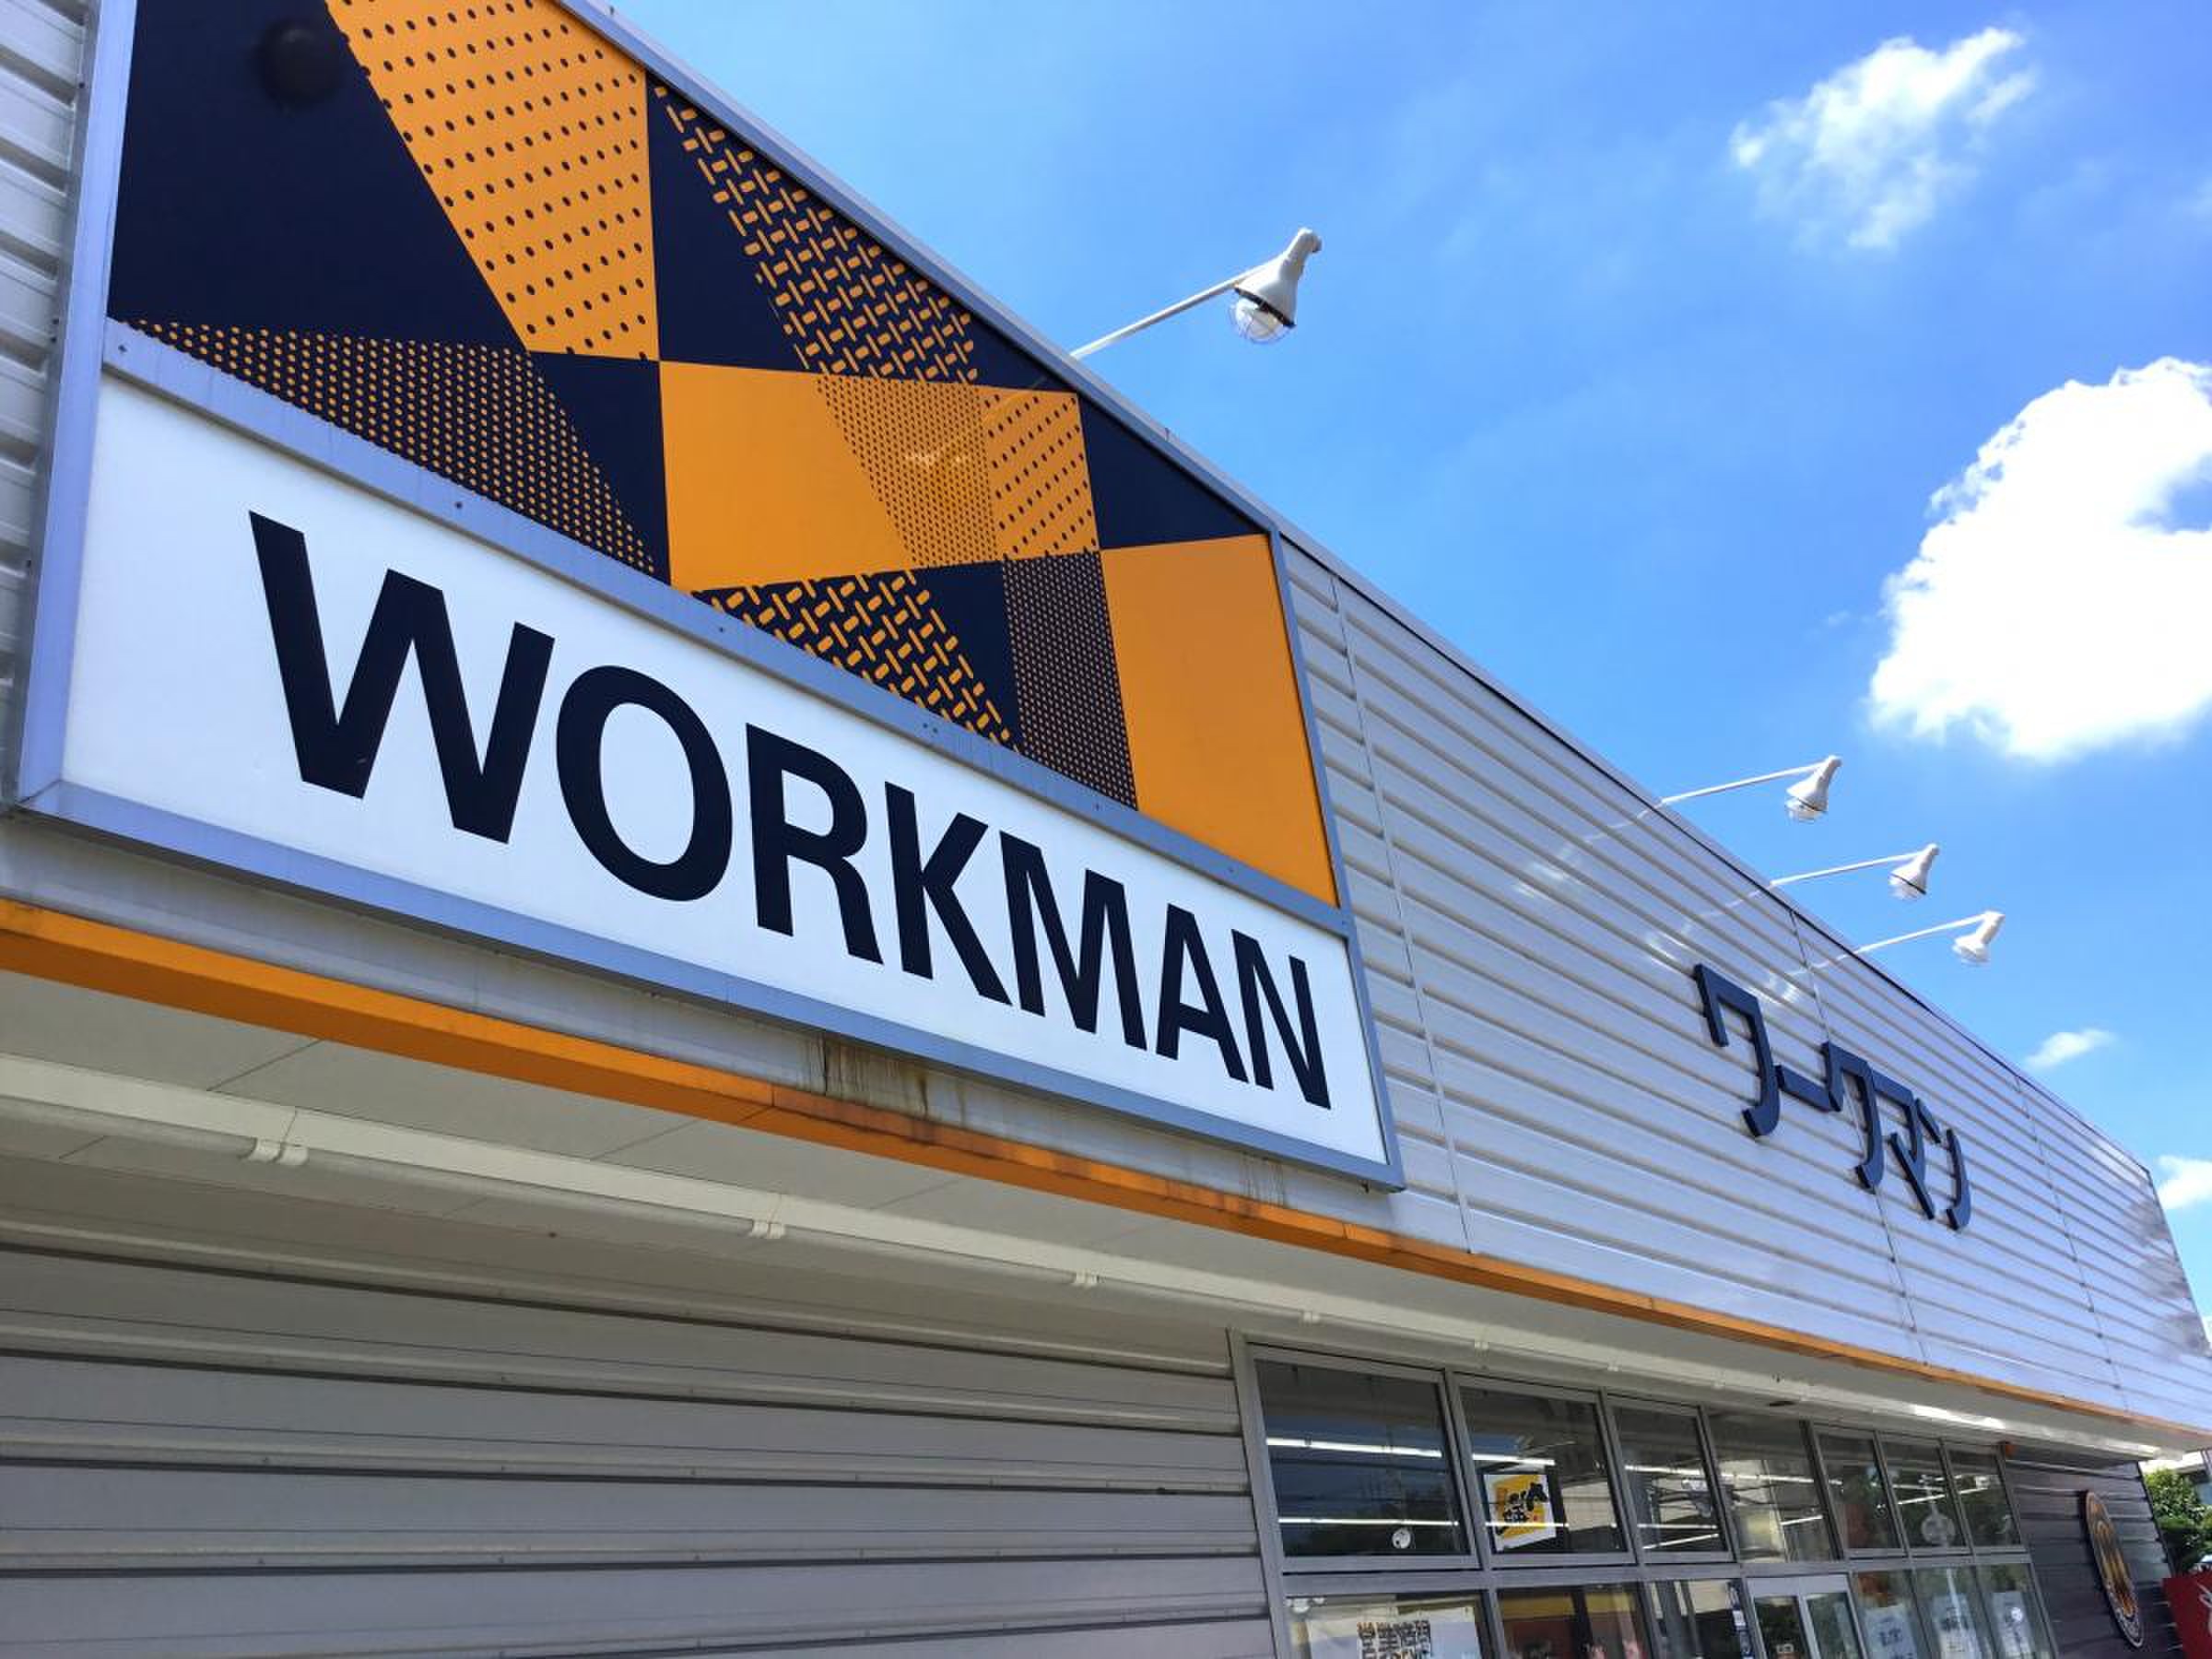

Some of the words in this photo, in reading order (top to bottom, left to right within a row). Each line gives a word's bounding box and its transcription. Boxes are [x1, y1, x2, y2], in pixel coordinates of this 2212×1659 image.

[249, 512, 1331, 1110] WORKMAN
[1694, 964, 1972, 1230] ワークマン
